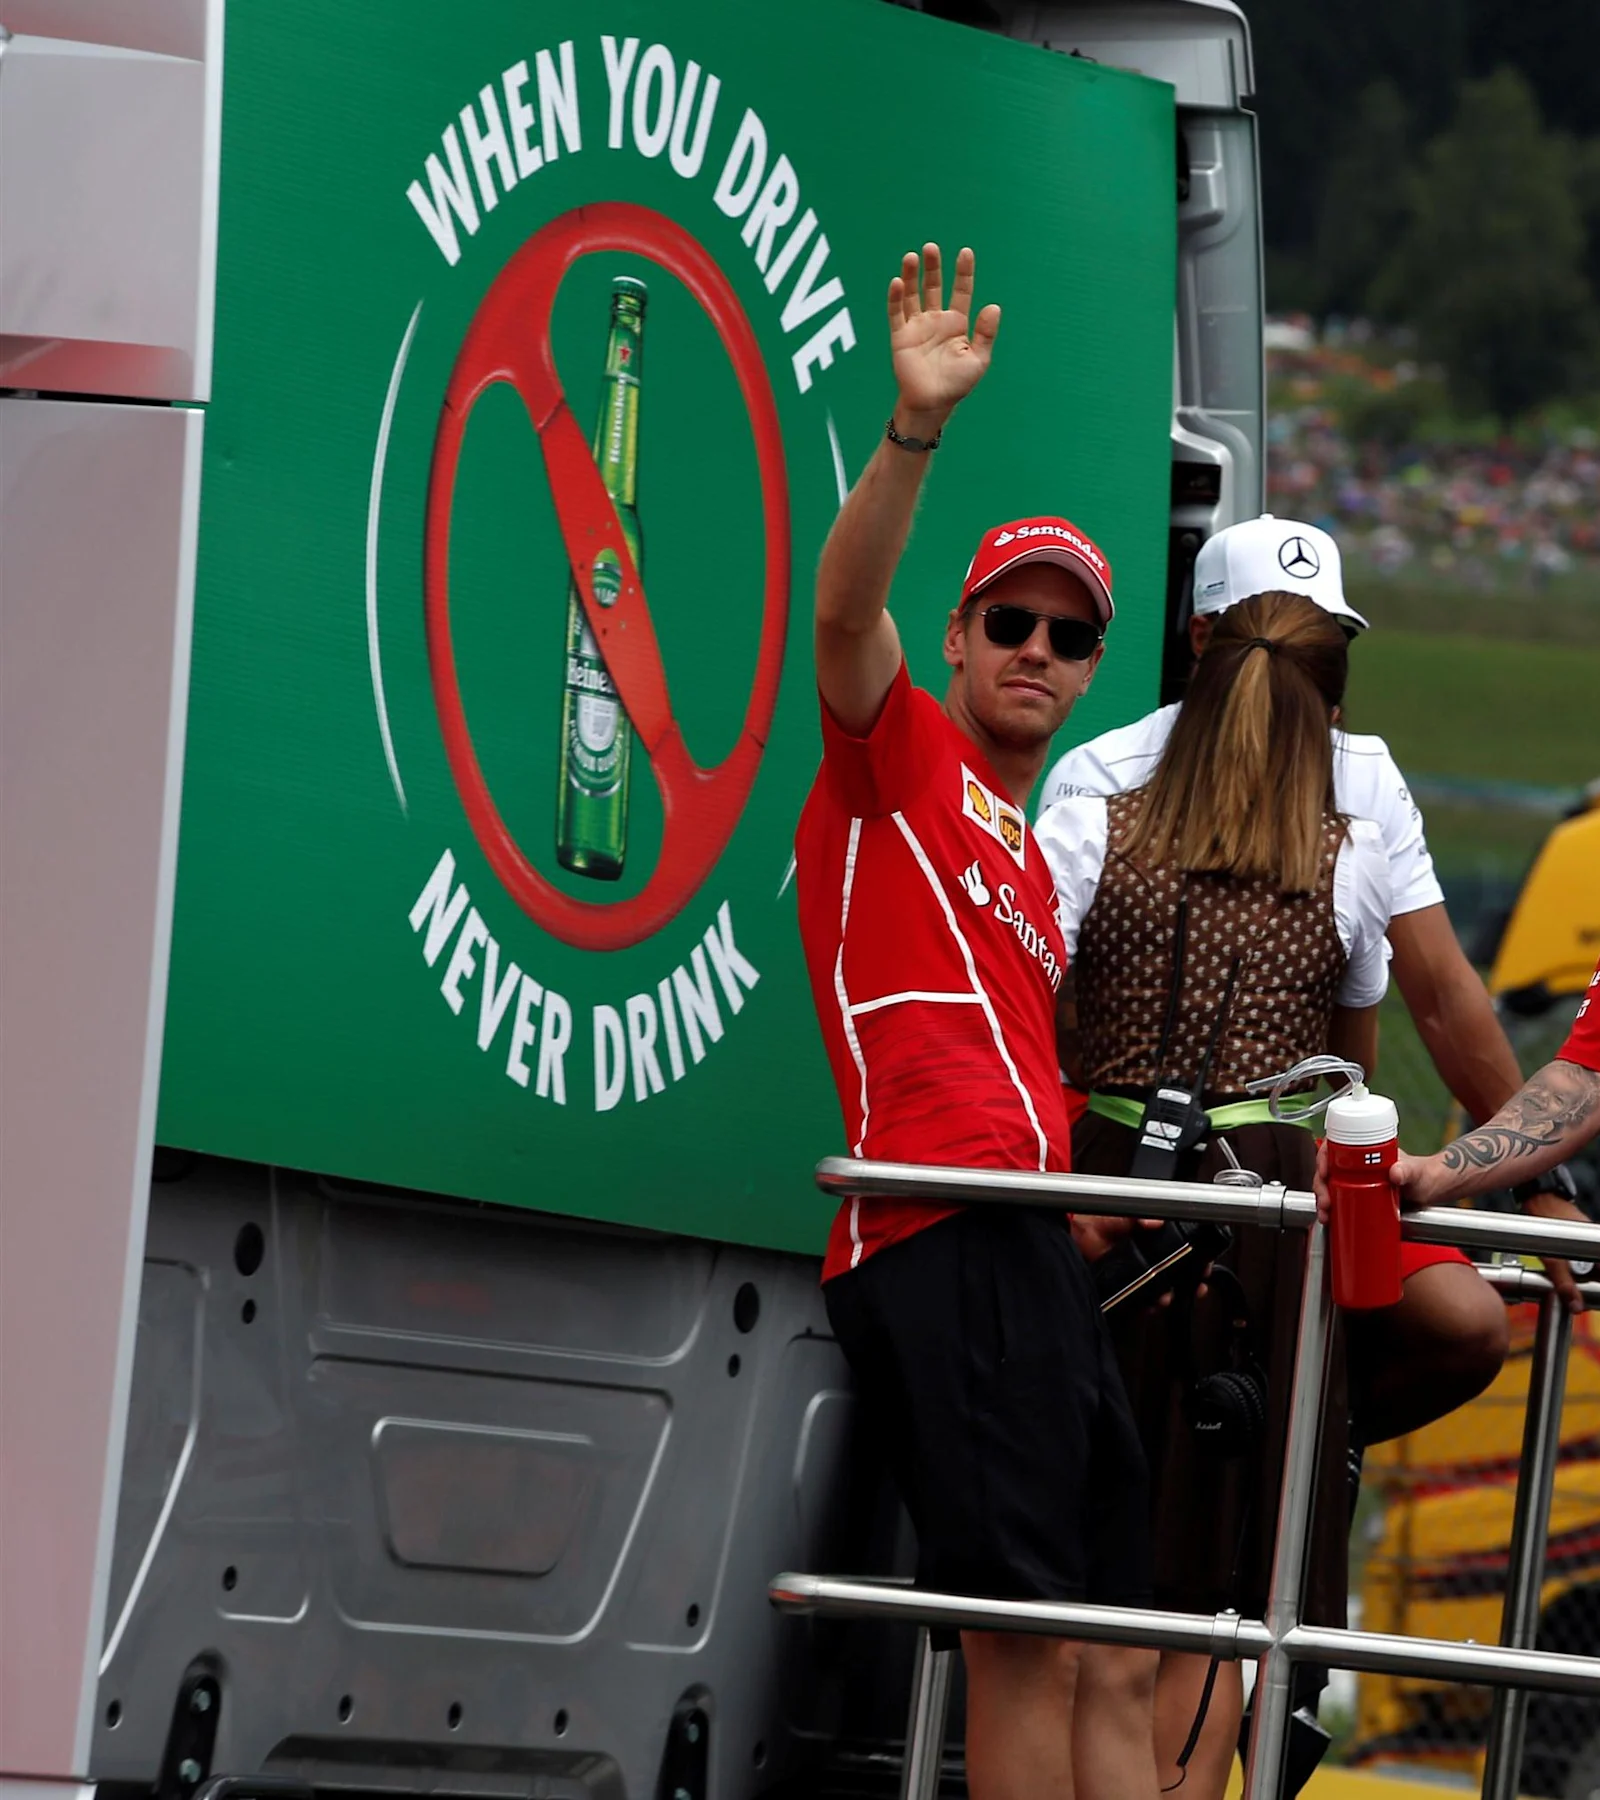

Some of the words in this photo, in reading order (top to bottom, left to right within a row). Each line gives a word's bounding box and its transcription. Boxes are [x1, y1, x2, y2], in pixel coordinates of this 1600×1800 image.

[406, 40, 581, 266] WHEN
[601, 35, 720, 178] YOU
[713, 108, 856, 394] DRIVE
[1016, 526, 1104, 570] Santander
[1000, 817, 1021, 848] ups
[408, 848, 572, 1105] NEVER
[594, 900, 760, 1111] DRINK
